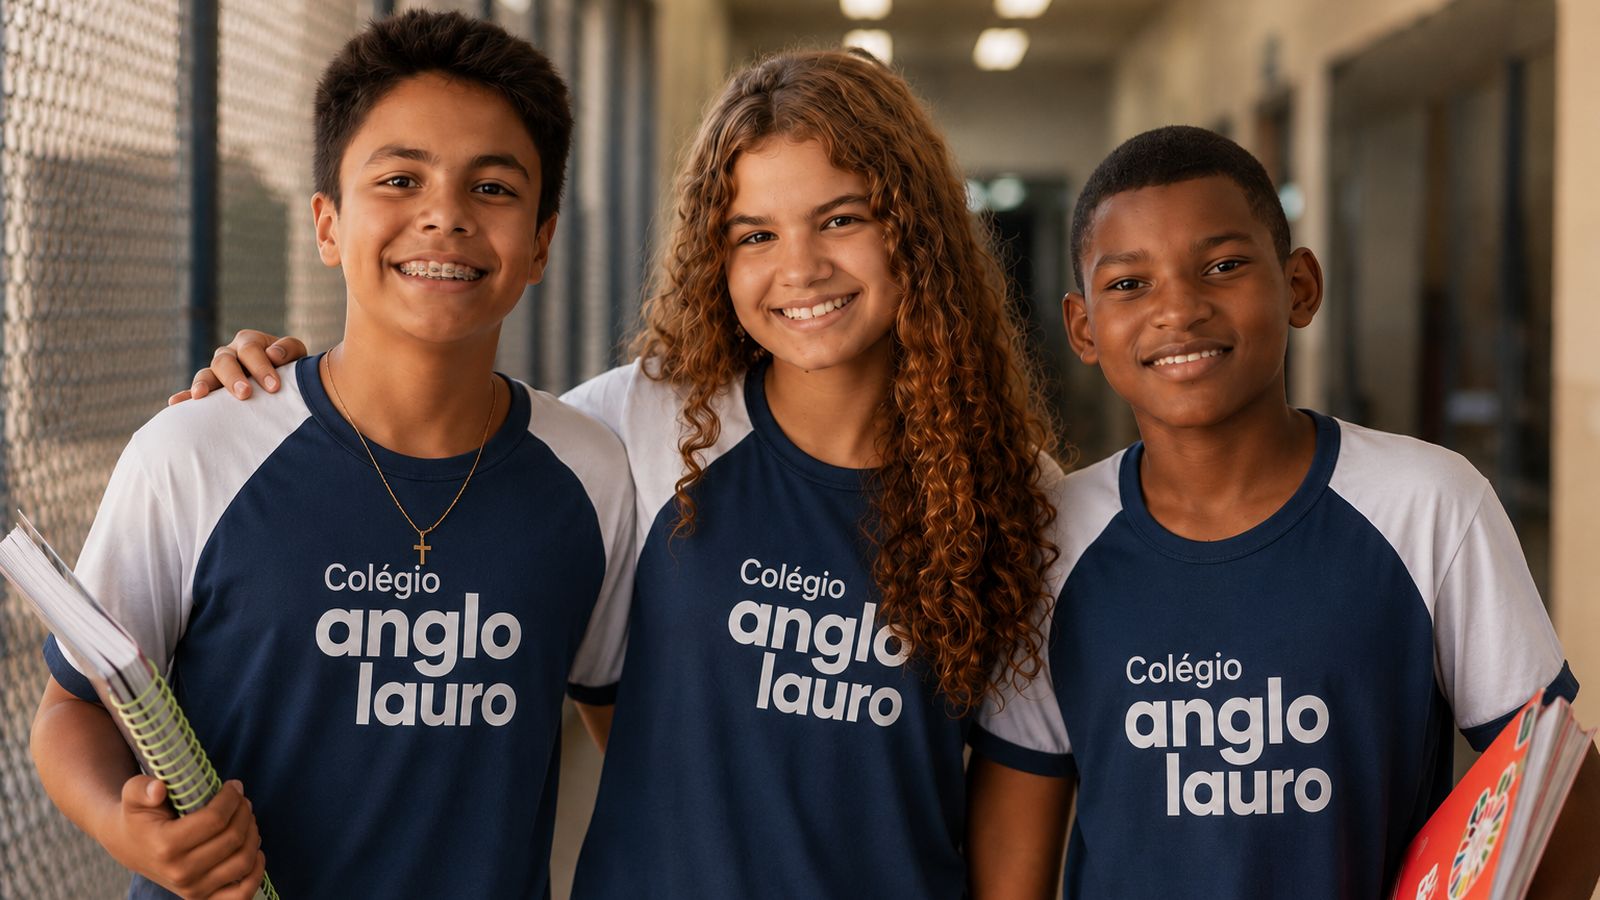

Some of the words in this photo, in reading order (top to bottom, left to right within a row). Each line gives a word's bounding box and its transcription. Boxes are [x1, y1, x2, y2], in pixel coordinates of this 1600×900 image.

[324, 563, 441, 600] Colégio
[738, 558, 846, 601] Colégio
[315, 592, 522, 678] anglo
[727, 601, 913, 676] anglo
[355, 662, 517, 727] lauro
[755, 651, 903, 727] lauro
[1125, 651, 1243, 689] Colégio
[1124, 676, 1330, 766] anglo
[1165, 752, 1333, 816] lauro
